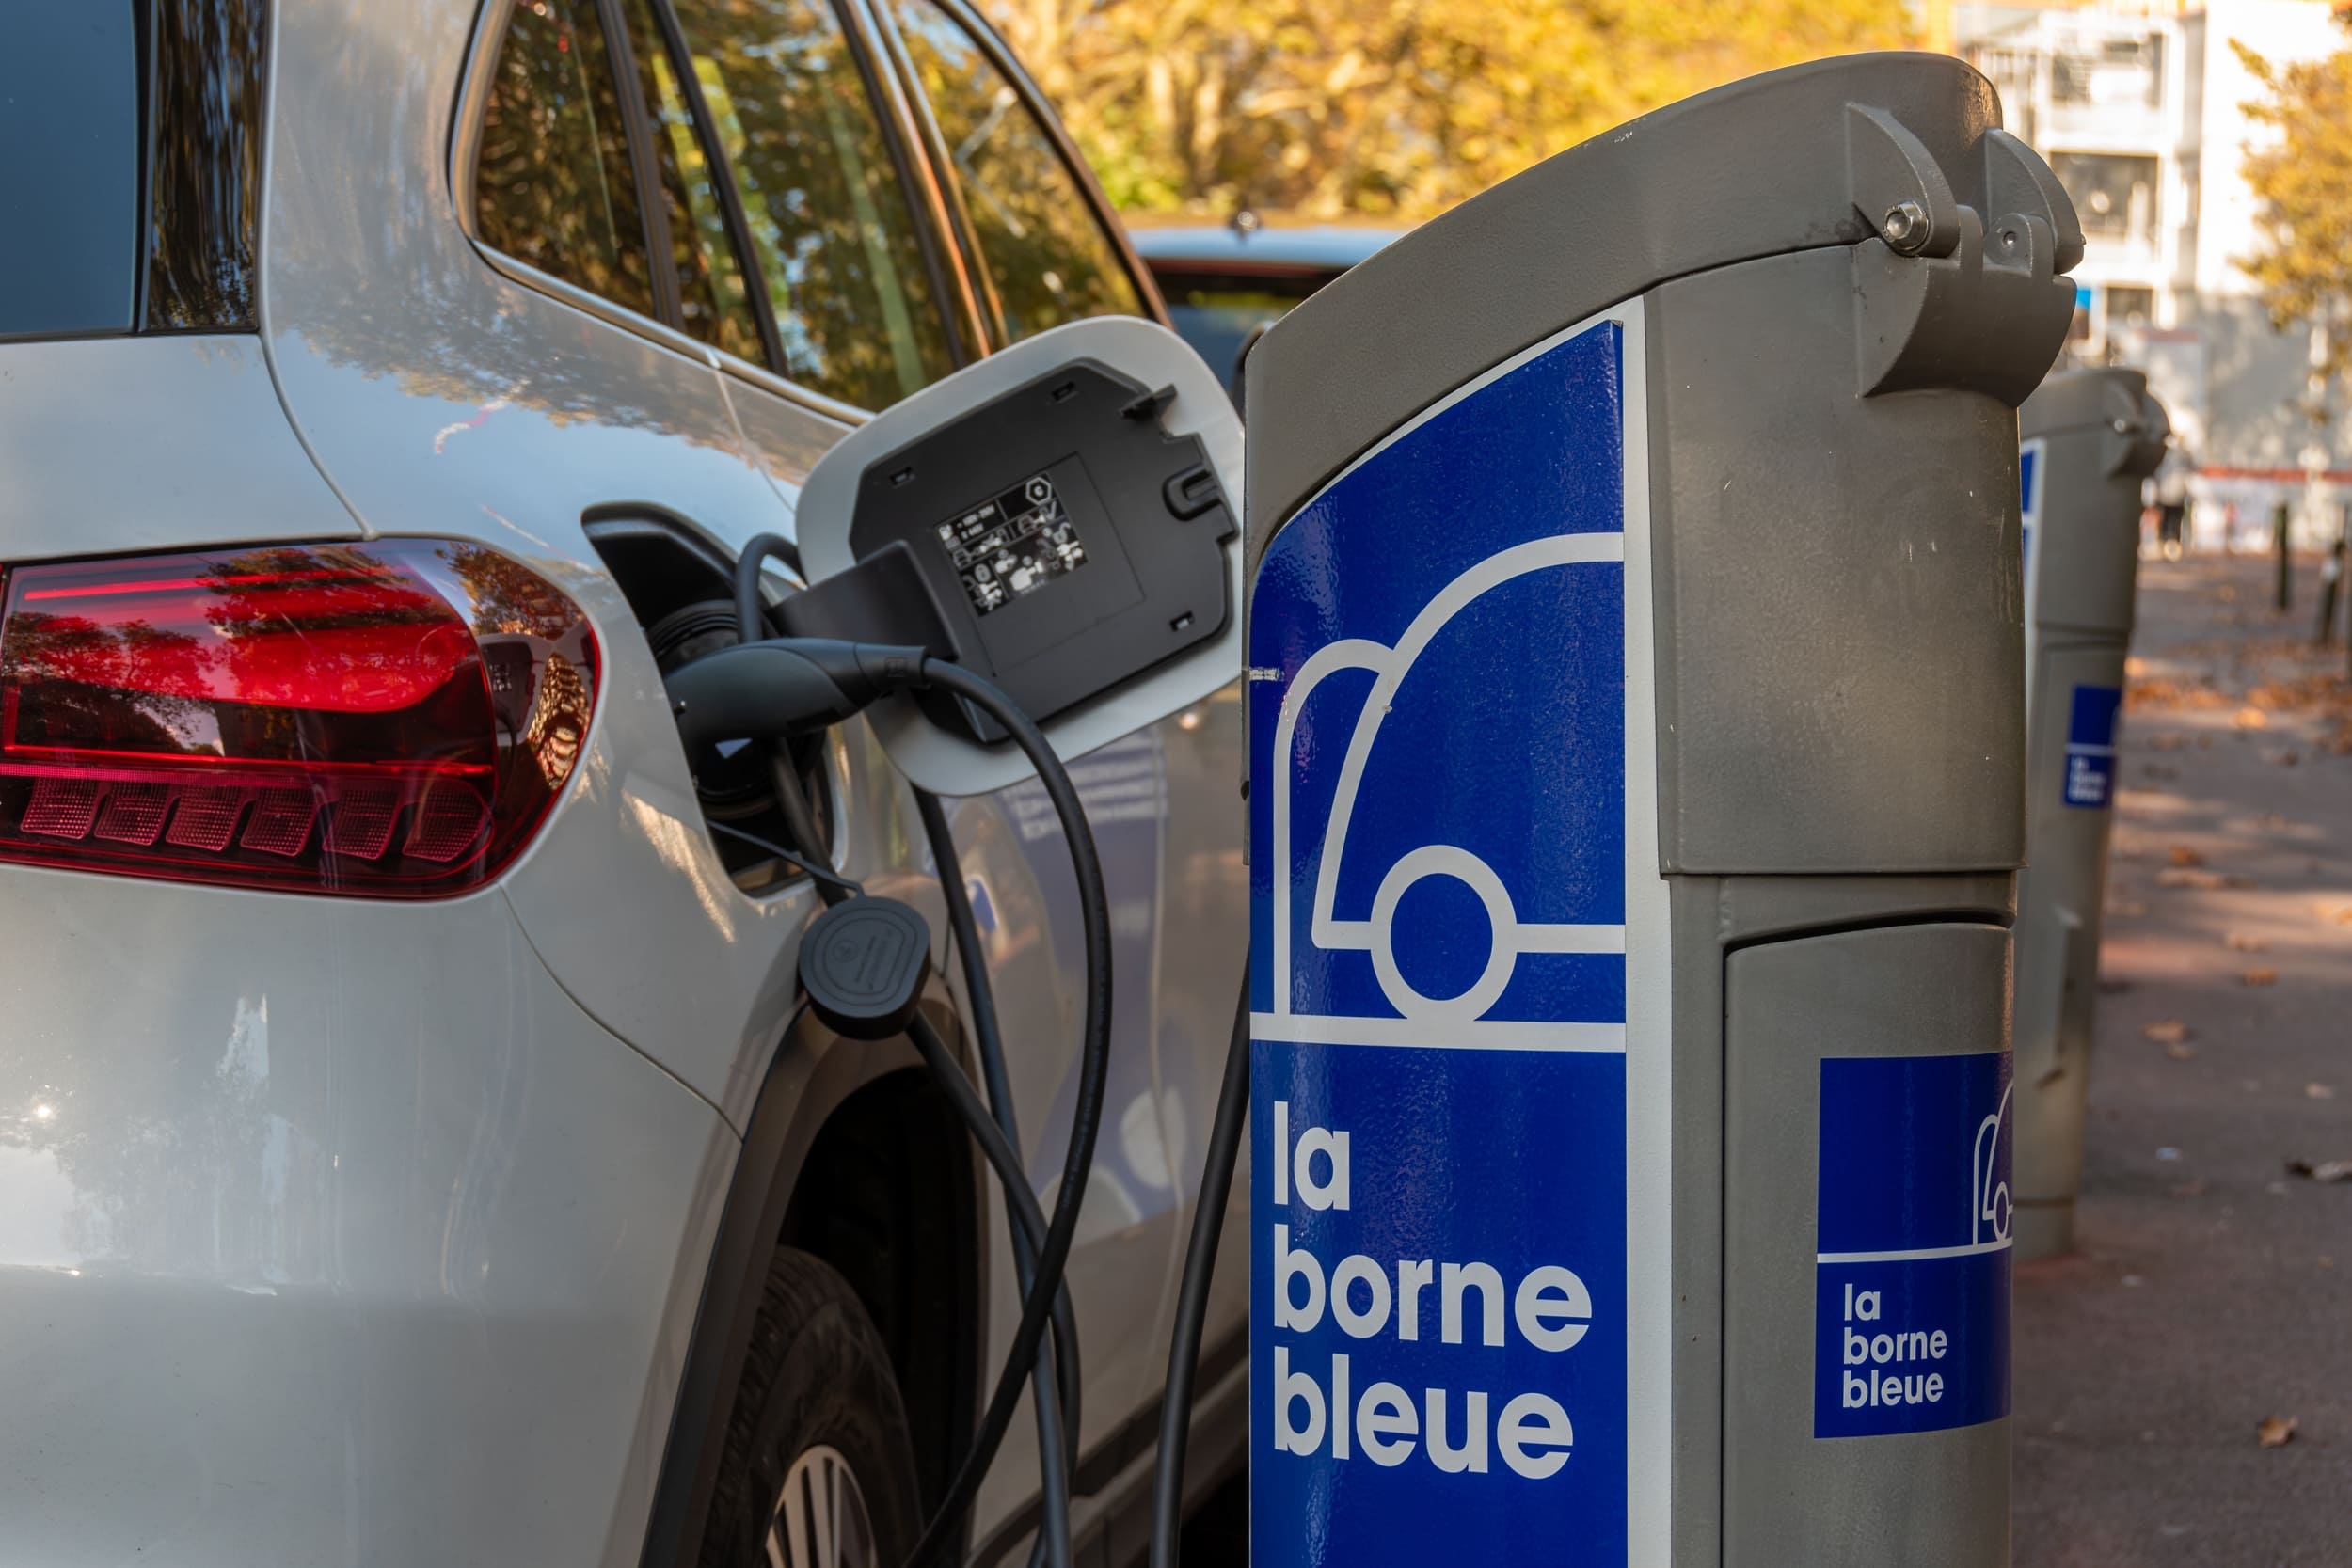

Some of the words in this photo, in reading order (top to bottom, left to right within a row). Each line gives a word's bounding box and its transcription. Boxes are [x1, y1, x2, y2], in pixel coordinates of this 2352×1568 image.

[1274, 1101, 1350, 1211] la
[1274, 1223, 1593, 1353] borne
[1844, 1283, 1881, 1322] la
[1843, 1326, 1947, 1365] borne
[1274, 1345, 1574, 1480] bleue
[1842, 1370, 1944, 1409] bleue
